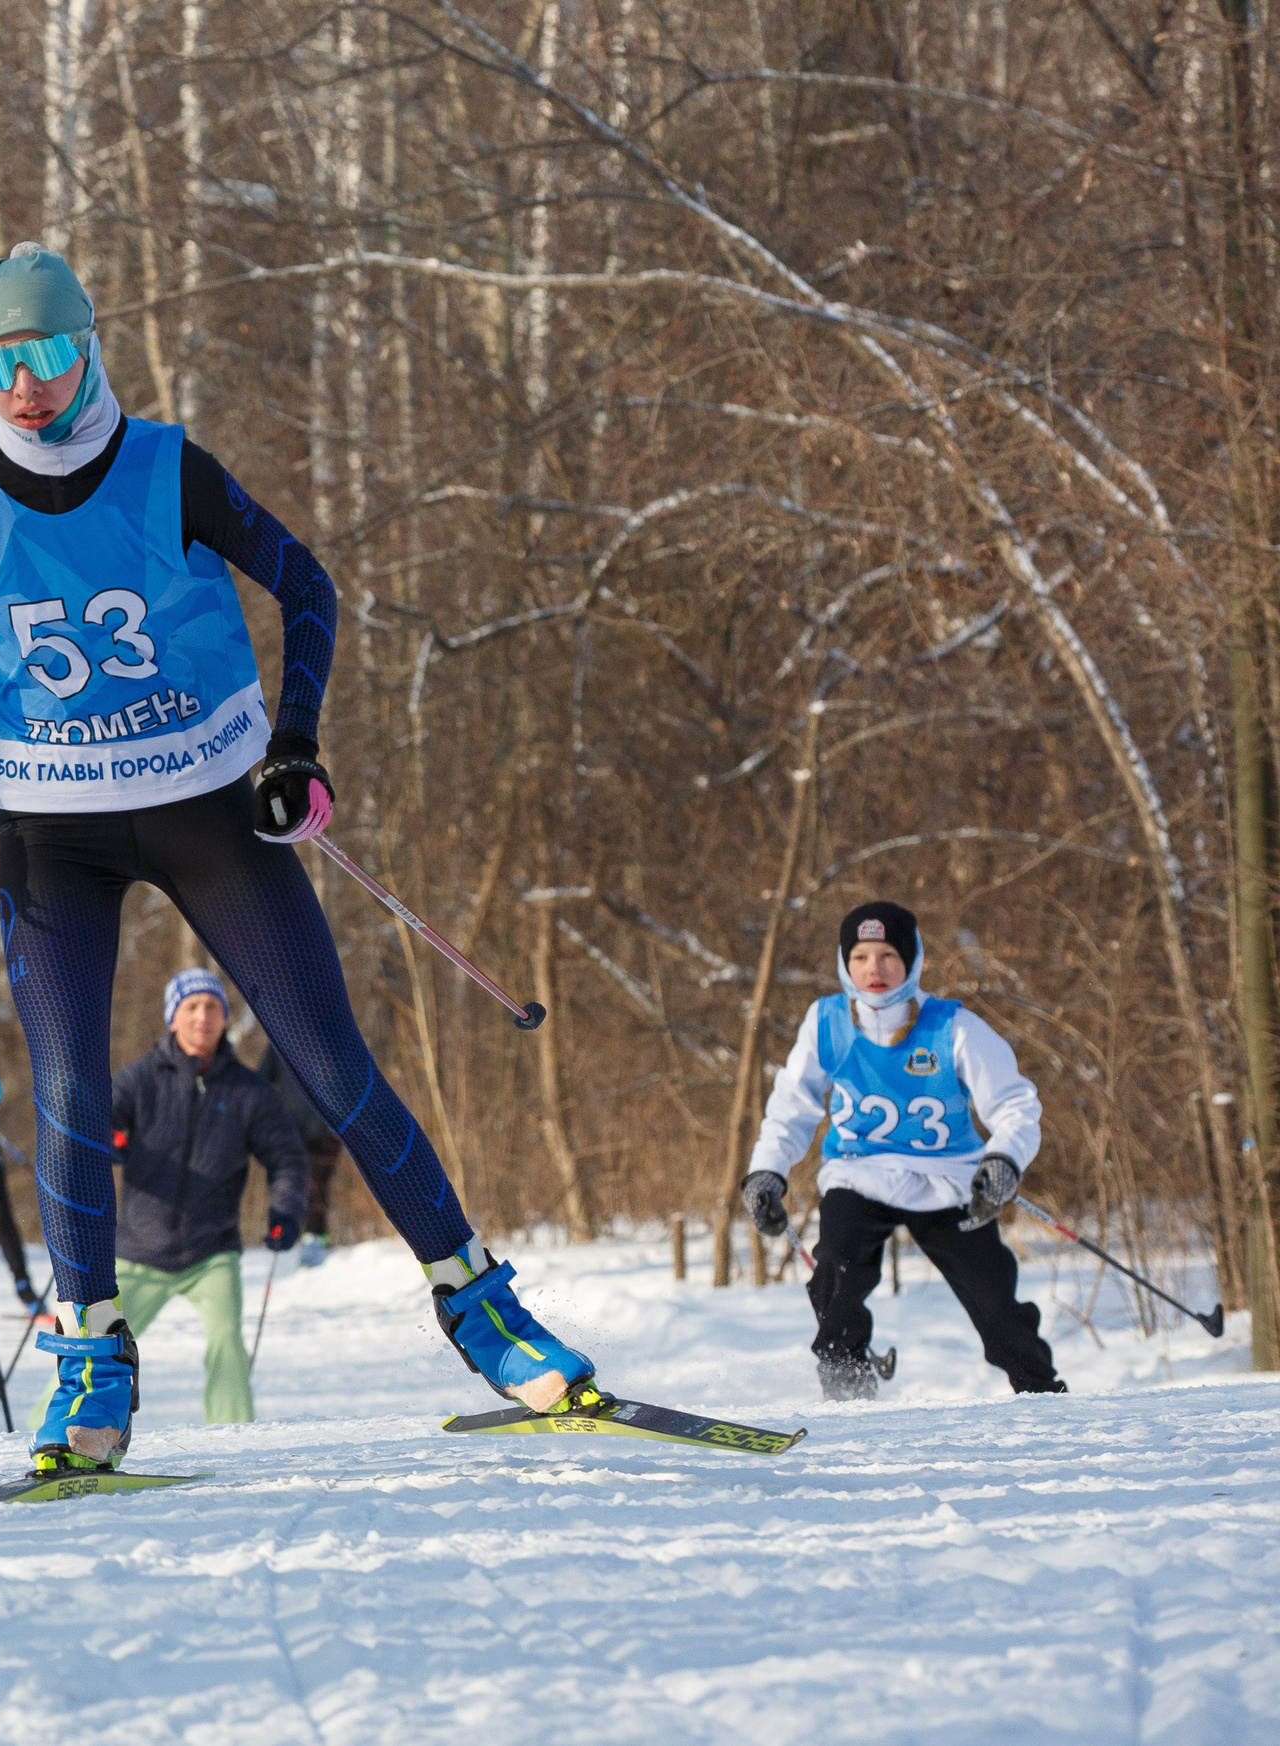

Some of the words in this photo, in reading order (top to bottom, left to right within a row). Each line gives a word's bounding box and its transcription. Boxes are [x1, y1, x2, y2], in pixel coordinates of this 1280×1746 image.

[8, 587, 160, 700] 53
[23, 688, 202, 744] ТЮМЕНЬ
[37, 762, 104, 781] ГЛАВЫ
[111, 750, 195, 780] ГОРОДА
[197, 710, 253, 762] ТЮМЕНИ
[831, 1082, 951, 1151] 223
[554, 1418, 599, 1432] FISCHER
[698, 1423, 791, 1454] FISCHER
[58, 1478, 99, 1499] FISCHER
